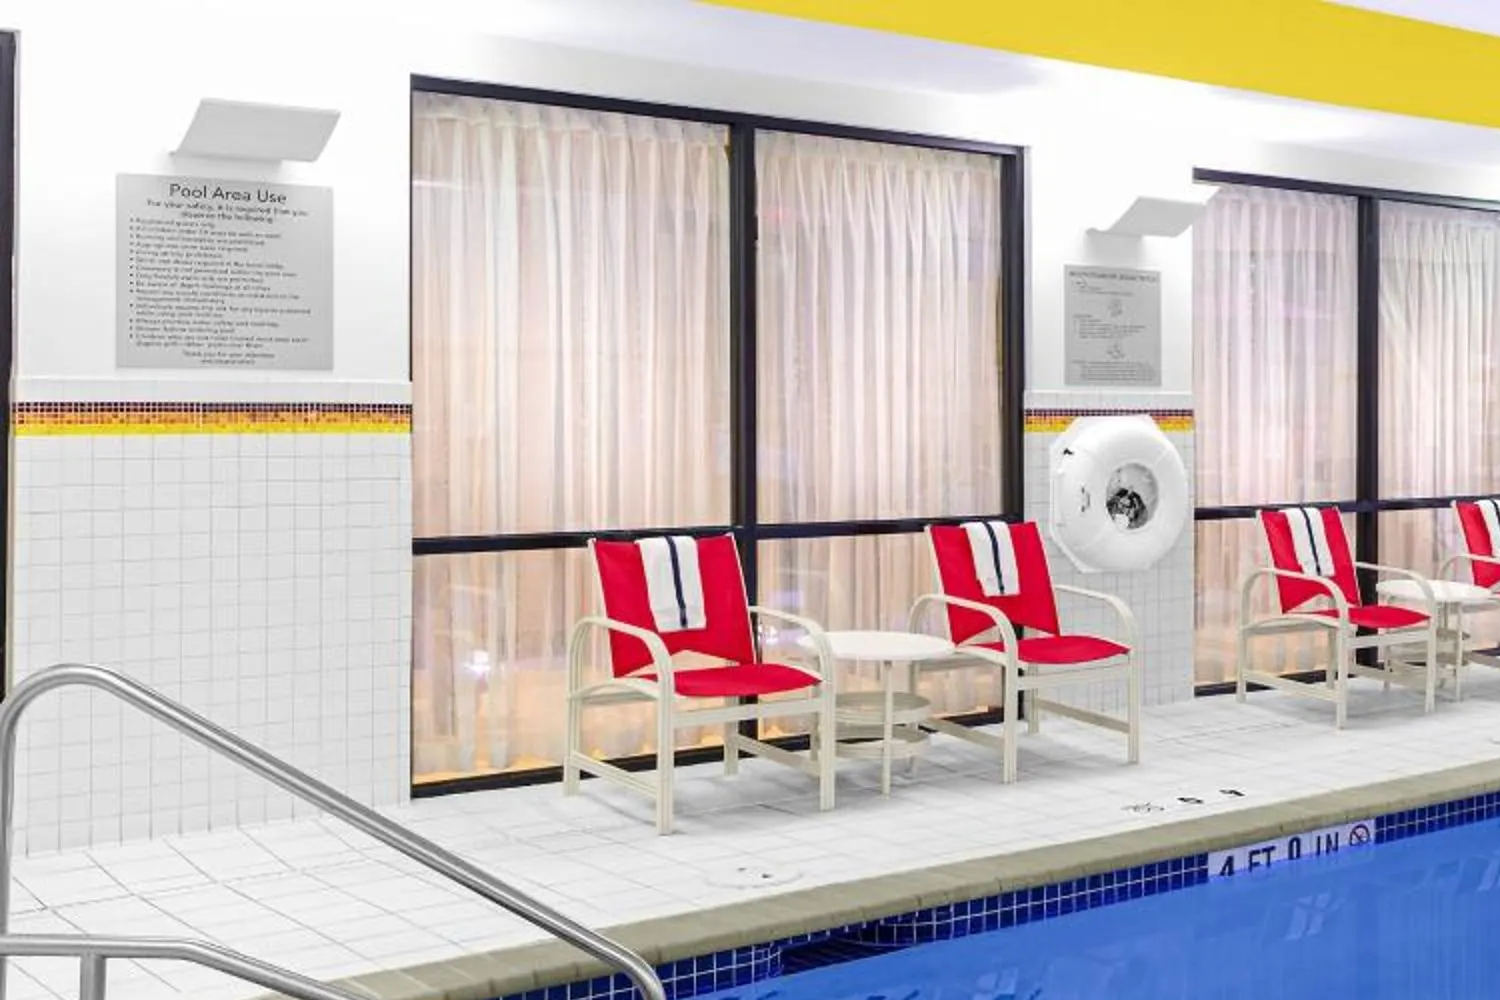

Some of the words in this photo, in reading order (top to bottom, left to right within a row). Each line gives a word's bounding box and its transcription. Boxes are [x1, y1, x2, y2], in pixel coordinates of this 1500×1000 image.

[169, 183, 207, 199] Pool
[212, 186, 251, 202] Area
[256, 189, 287, 205] Use
[1219, 855, 1236, 876] 4
[1248, 845, 1276, 872] FT
[1316, 831, 1340, 856] IN
